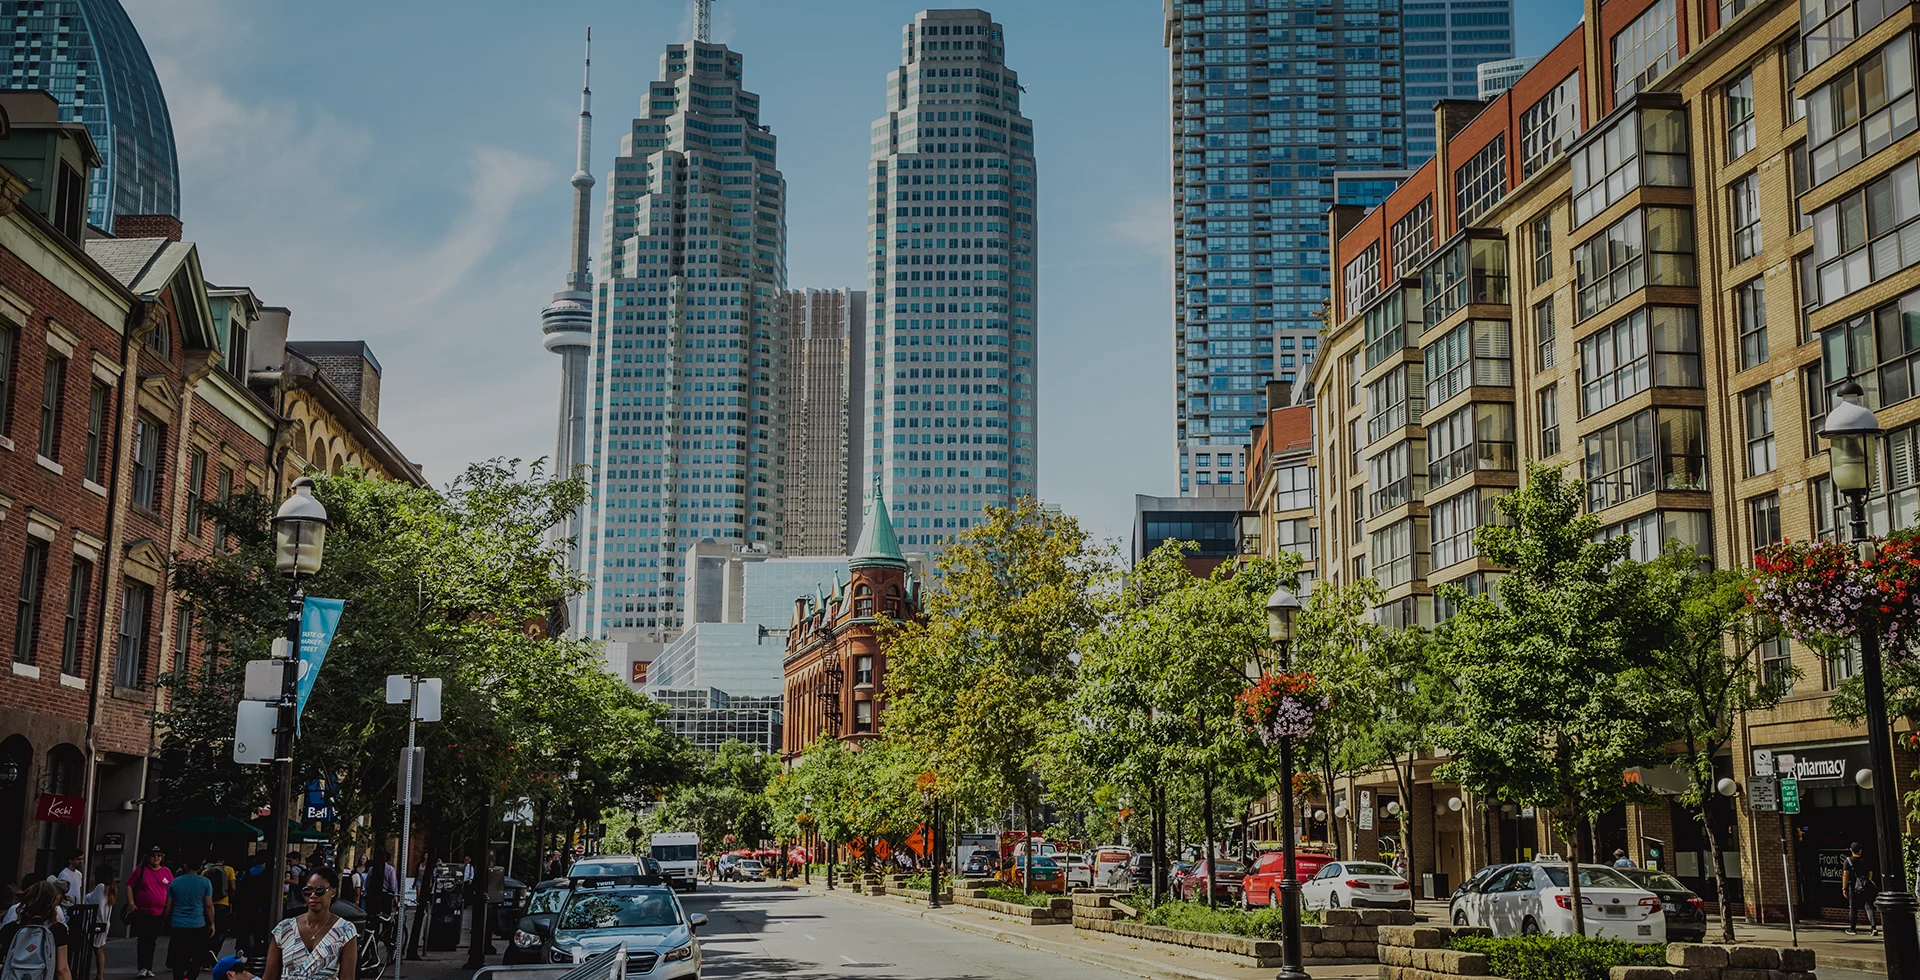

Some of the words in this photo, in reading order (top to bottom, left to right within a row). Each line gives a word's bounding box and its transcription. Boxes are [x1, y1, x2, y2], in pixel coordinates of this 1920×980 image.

[1797, 757, 1846, 780] pharmacy
[1819, 853, 1839, 865] Front
[1820, 866, 1843, 878] Marke
